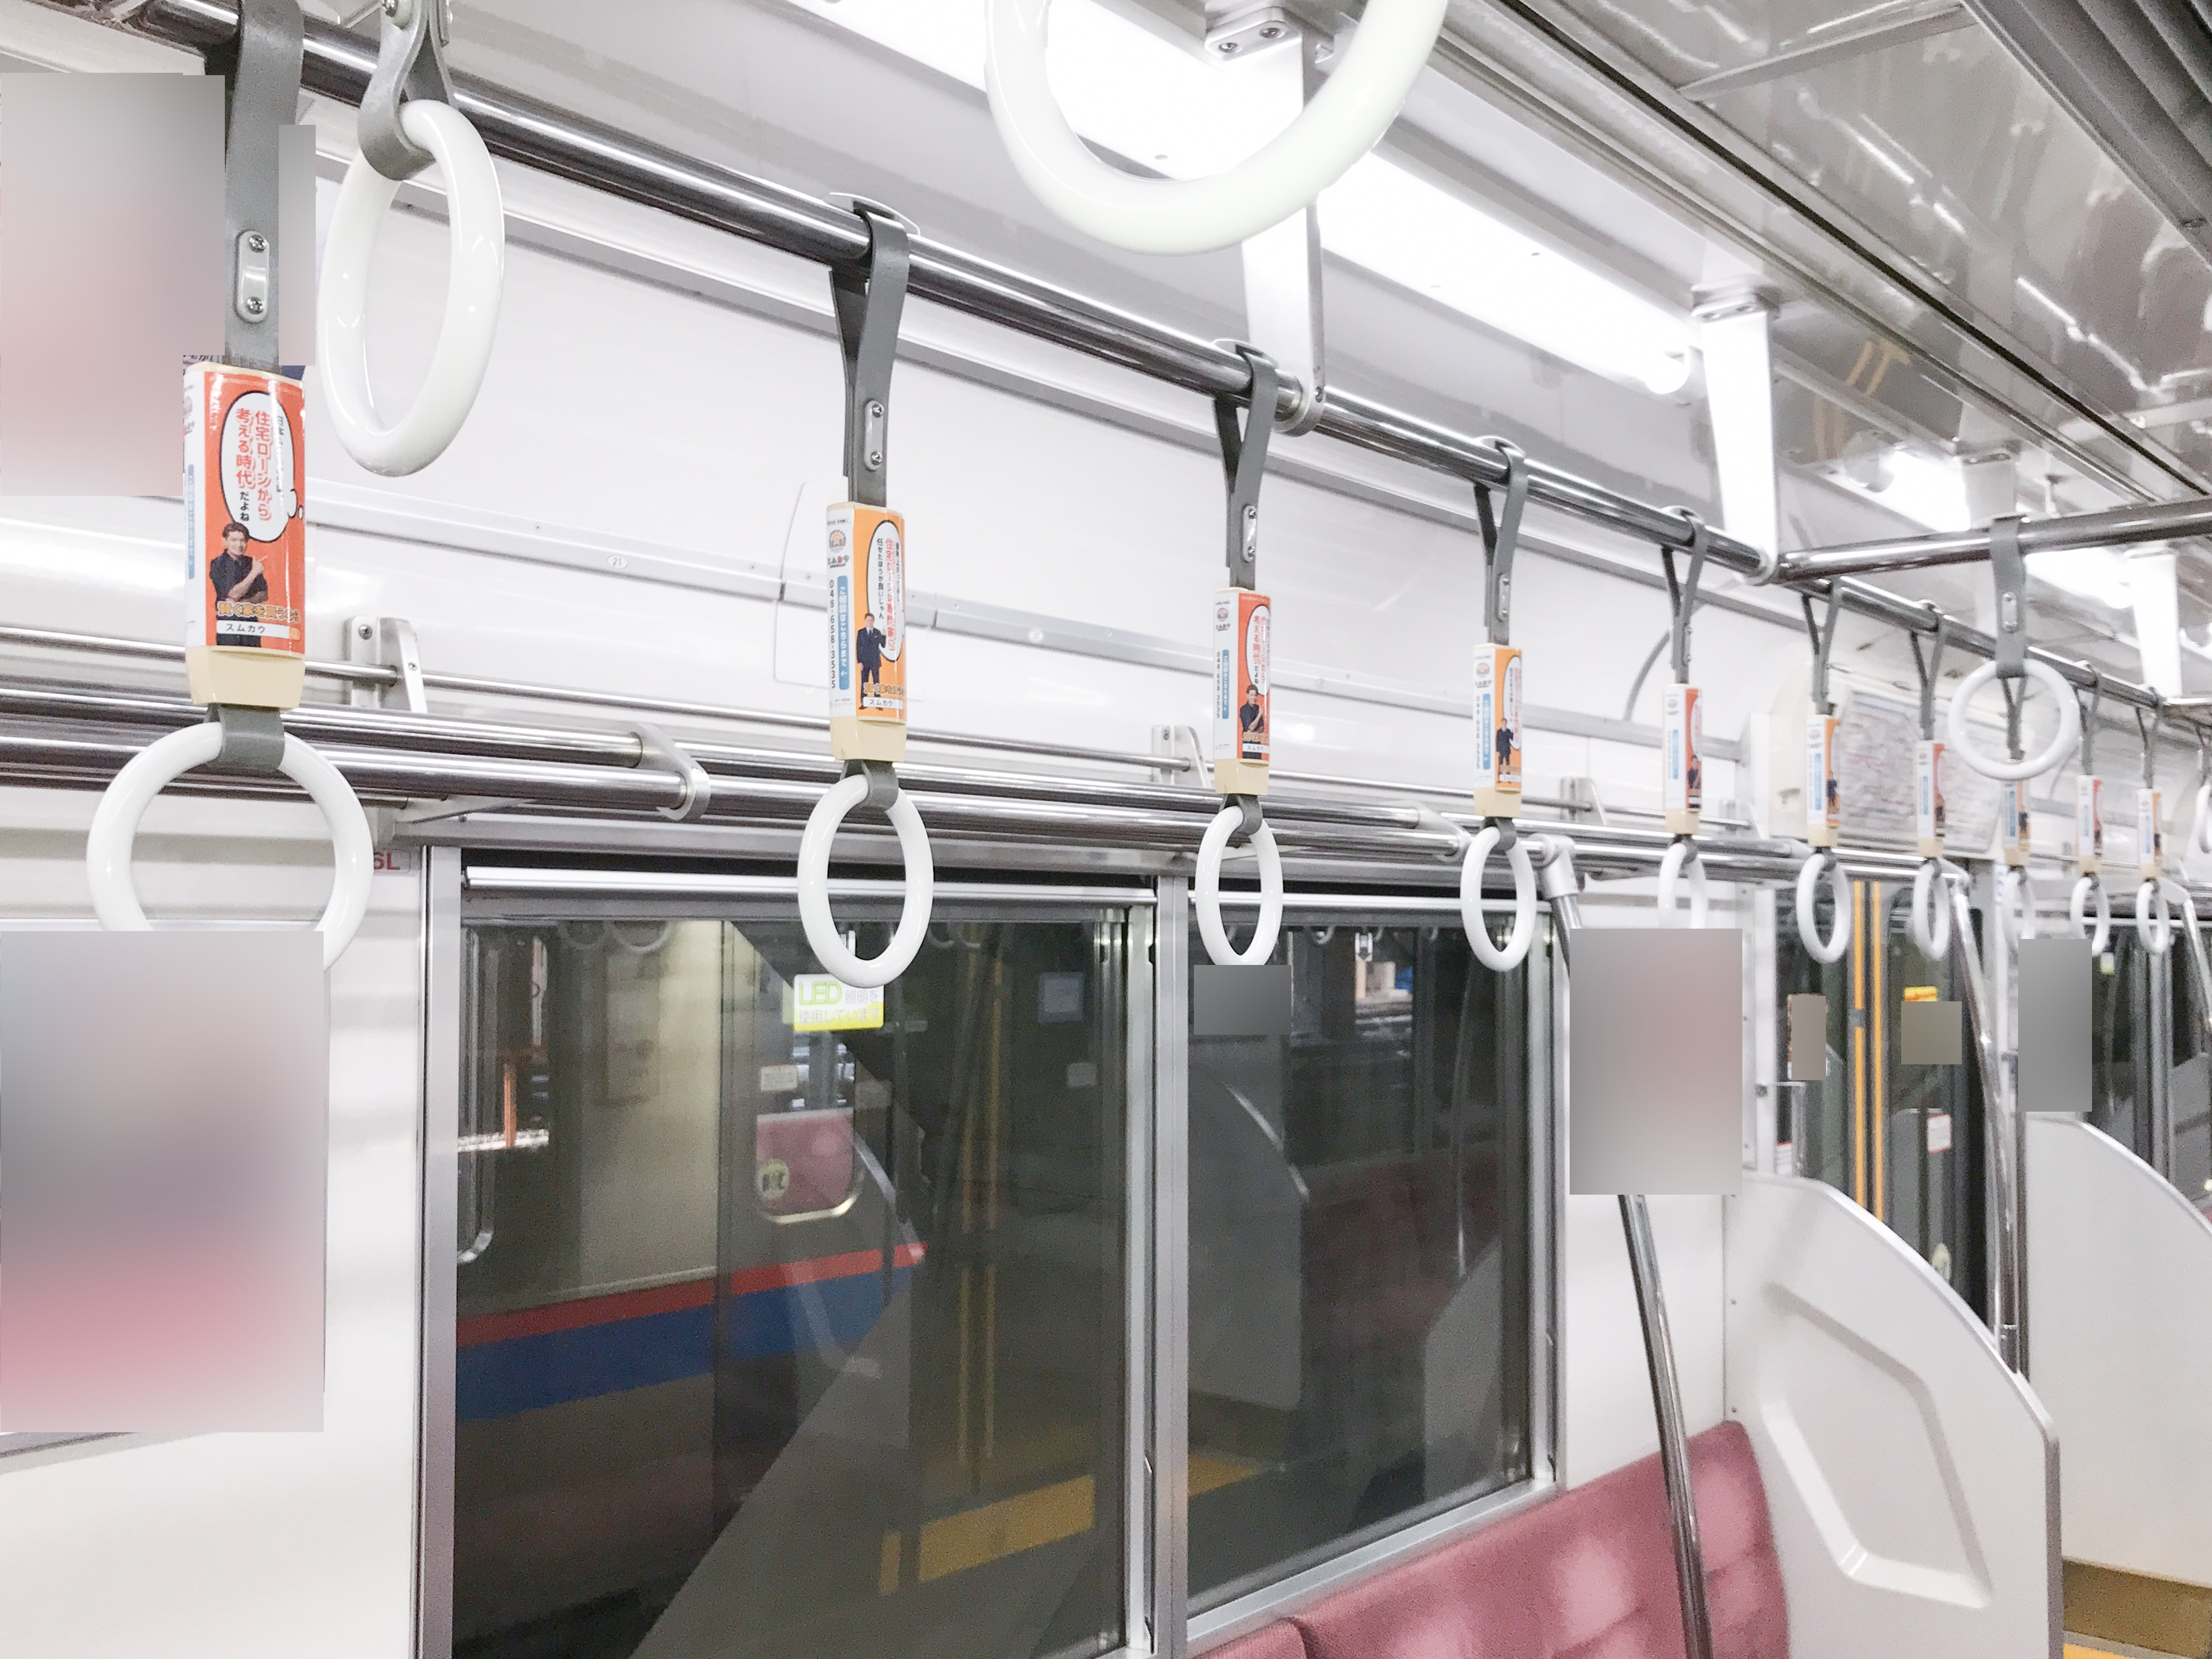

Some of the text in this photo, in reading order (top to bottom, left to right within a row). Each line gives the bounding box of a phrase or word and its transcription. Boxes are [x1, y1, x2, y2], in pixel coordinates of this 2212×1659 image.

[613, 556, 622, 567] 21
[226, 623, 265, 634] スムカウ
[869, 699, 893, 707] スムカウ
[799, 981, 842, 1005] LED
[799, 1007, 879, 1024] 使用しています
